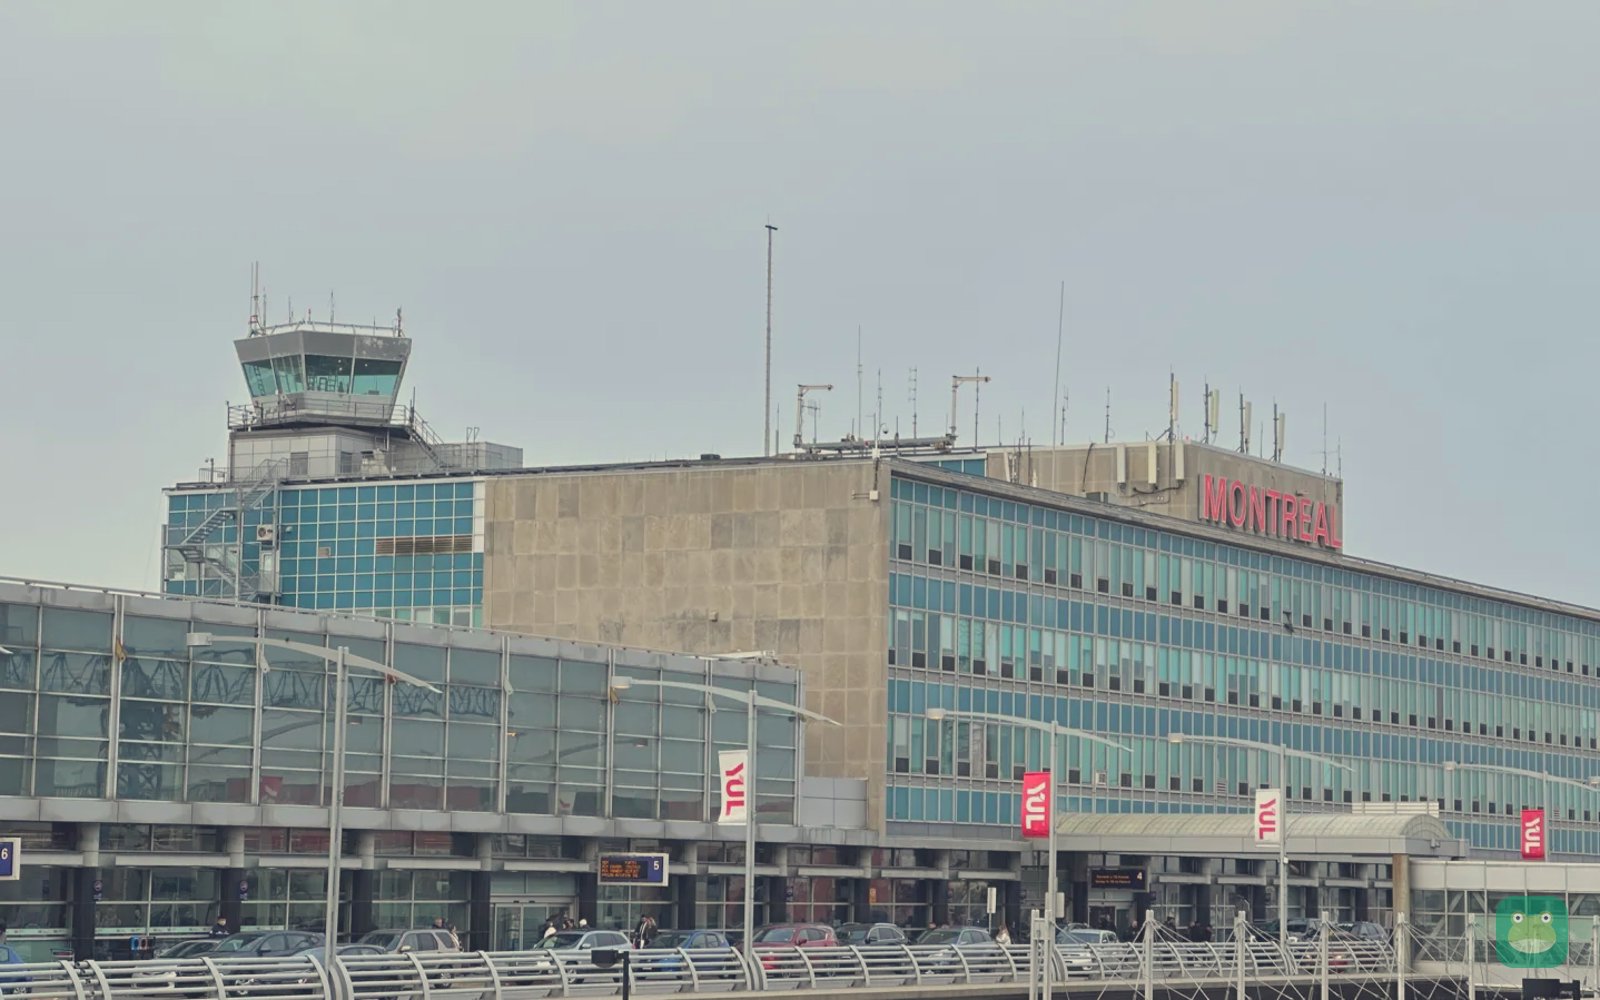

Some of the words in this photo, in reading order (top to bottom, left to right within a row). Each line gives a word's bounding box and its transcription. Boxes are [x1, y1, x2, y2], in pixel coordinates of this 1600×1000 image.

[725, 762, 745, 816] YUL
[1025, 782, 1046, 830] YUL
[1258, 798, 1276, 840] YUL
[1524, 817, 1541, 854] YUL
[1, 848, 9, 860] 6
[653, 860, 660, 871] 5
[1136, 871, 1143, 881] 4
